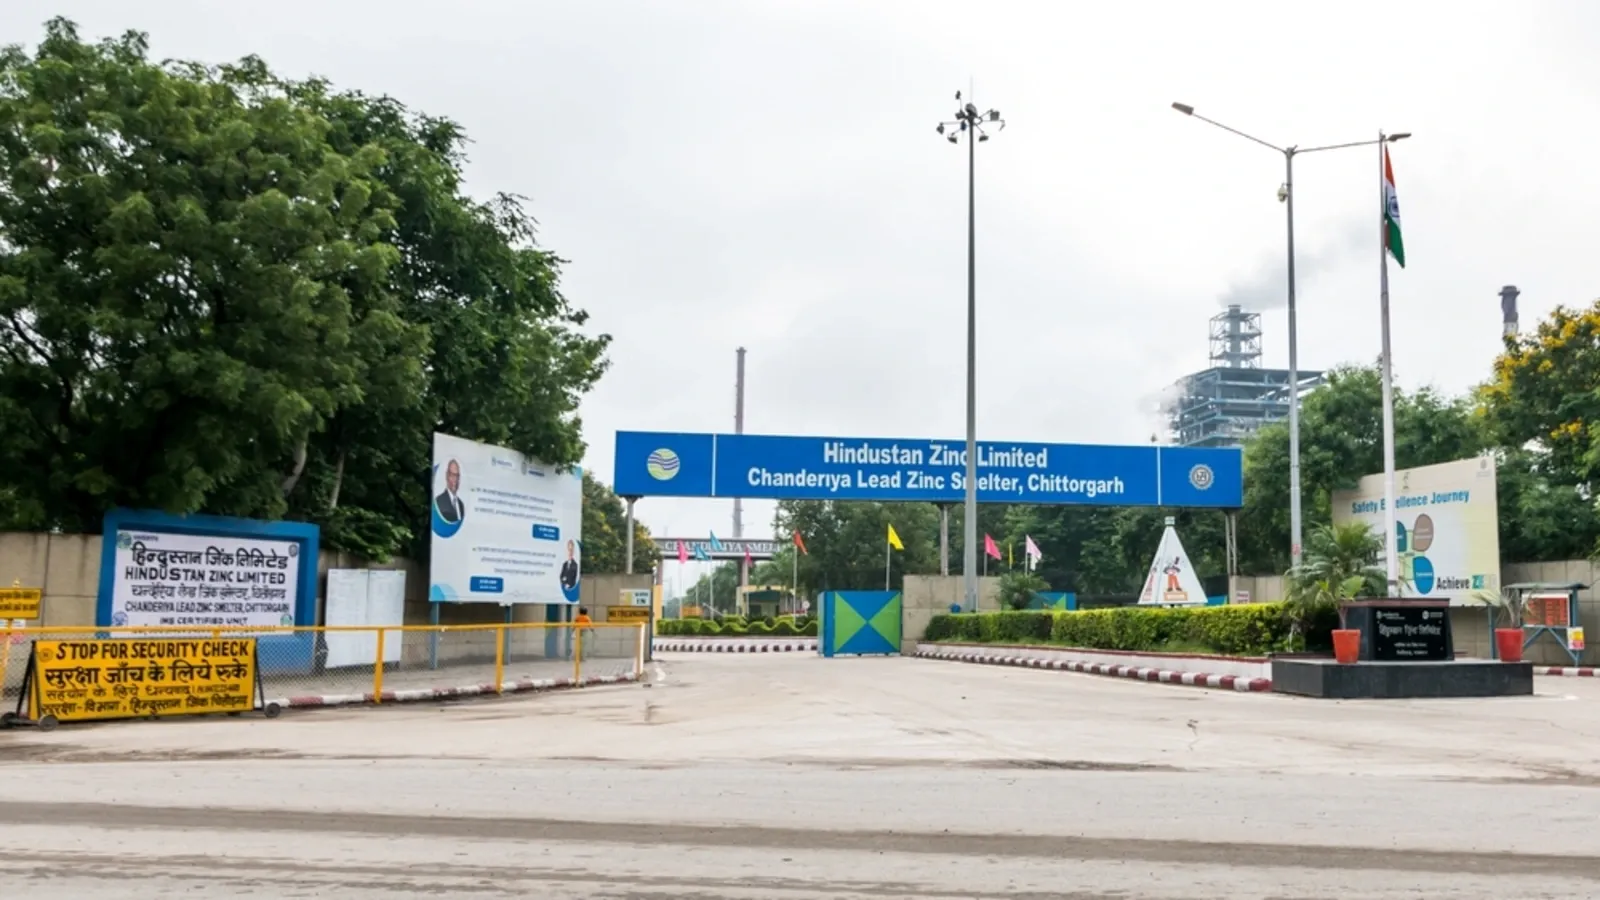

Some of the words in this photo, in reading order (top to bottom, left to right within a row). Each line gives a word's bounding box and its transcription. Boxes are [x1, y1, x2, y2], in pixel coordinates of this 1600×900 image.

[824, 442, 923, 465] Hindustan
[977, 446, 1048, 468] Limited
[748, 467, 851, 492] Chanderiya
[857, 470, 901, 488] Lead
[907, 471, 945, 489] Zinc
[1028, 474, 1124, 498] Chittorgarh
[1352, 499, 1378, 514] Safety
[1381, 495, 1428, 510] Eellence
[1431, 490, 1469, 506] Journey
[131, 541, 203, 568] हिन्दुस्तान
[204, 546, 235, 567] जिंक
[236, 548, 288, 570] लिमिटेड
[125, 566, 205, 581] HINDUSTAN
[209, 570, 234, 582] ZINC
[236, 572, 286, 584] LIMITED
[1437, 577, 1470, 590] Achieve
[125, 601, 174, 613] CHANDERIYA
[176, 602, 195, 613] LEAD
[196, 602, 213, 613] ZINC
[56, 642, 98, 660] STOP
[102, 642, 128, 660] FOR
[131, 641, 199, 659] SECURITY
[202, 641, 249, 657] CHECK
[45, 666, 101, 690] सुरक्षा
[103, 661, 145, 684] जाँच
[148, 660, 165, 682] के
[168, 659, 212, 684] लिये
